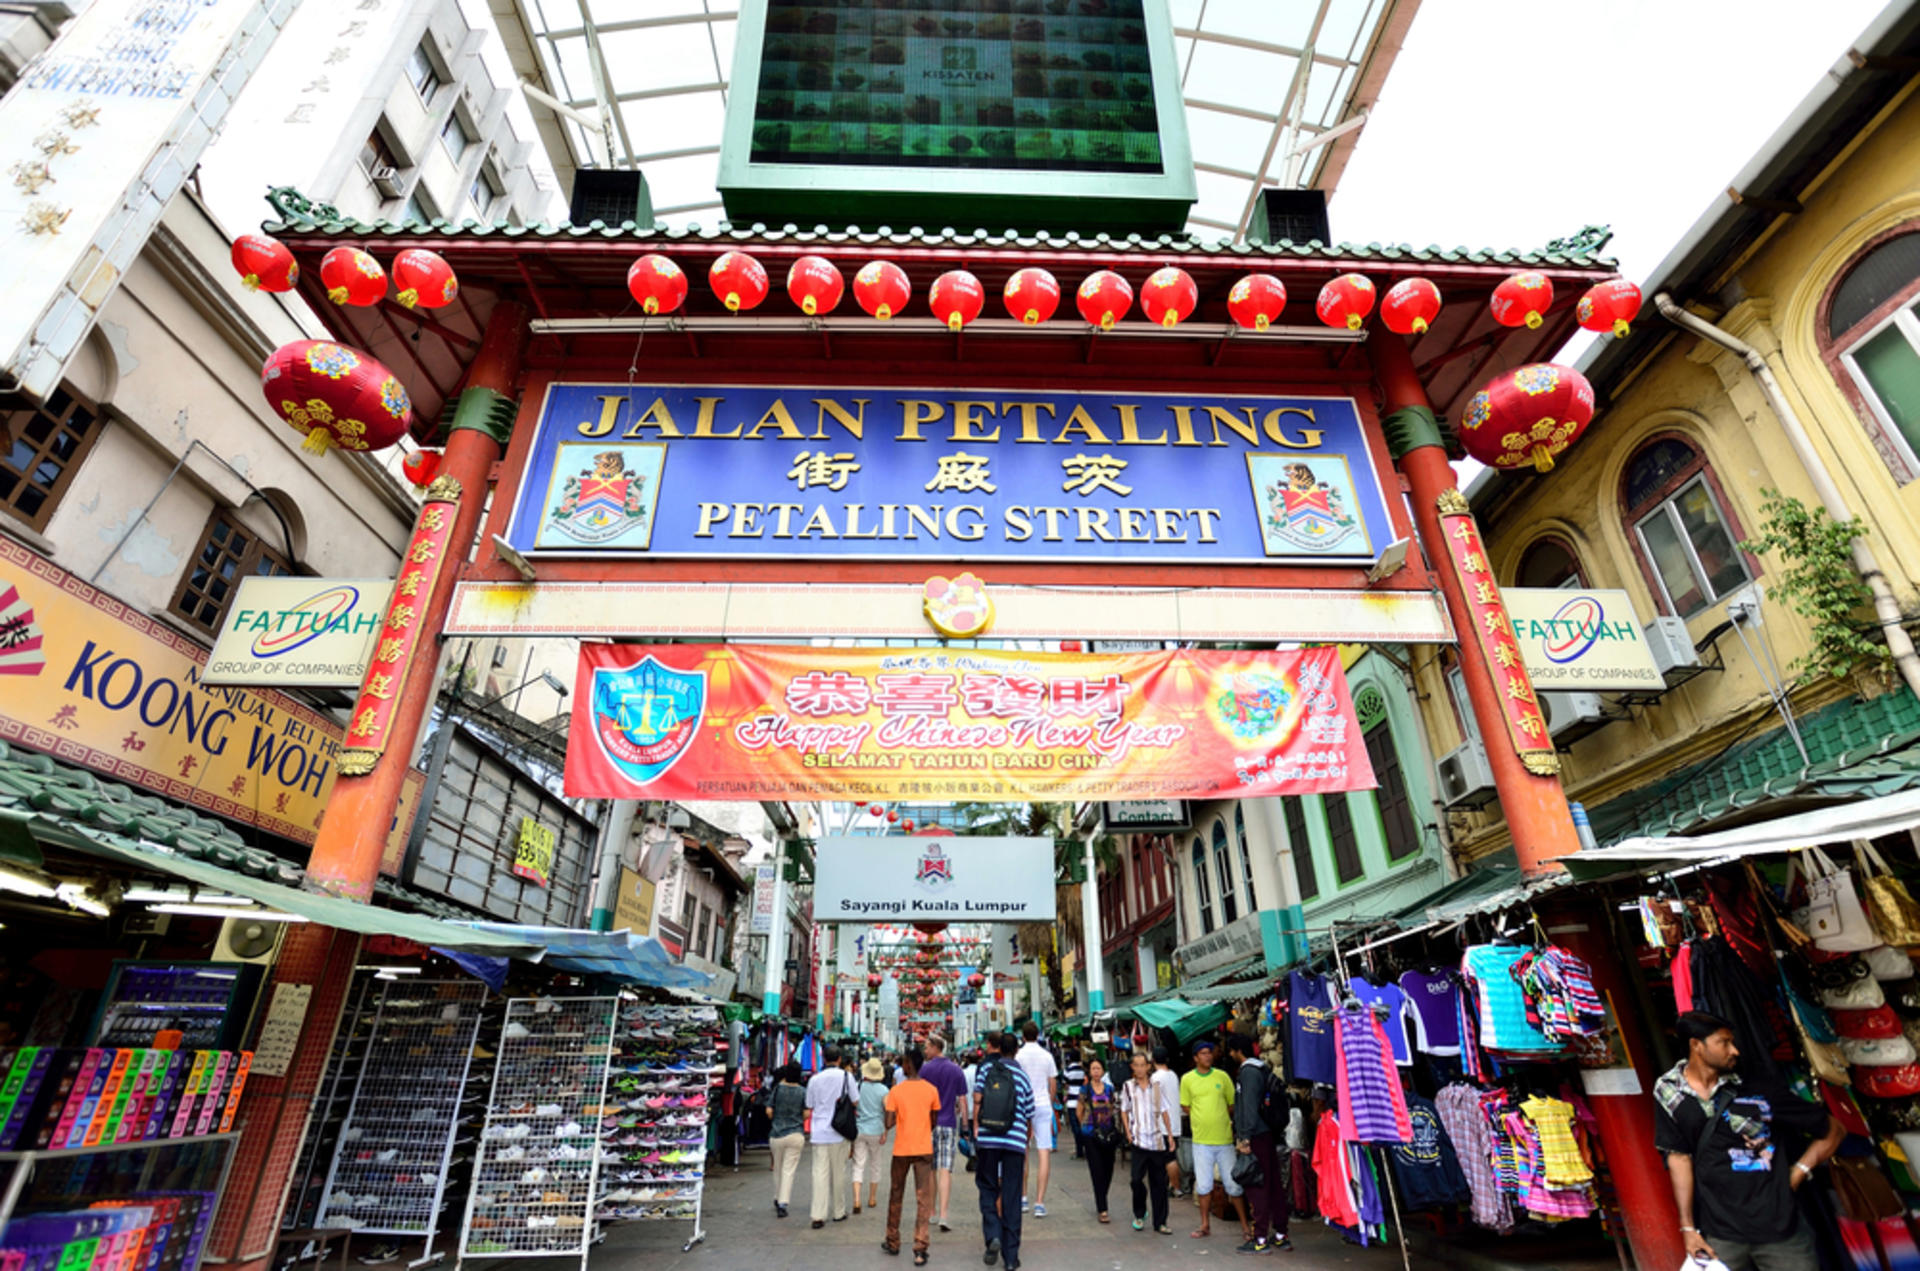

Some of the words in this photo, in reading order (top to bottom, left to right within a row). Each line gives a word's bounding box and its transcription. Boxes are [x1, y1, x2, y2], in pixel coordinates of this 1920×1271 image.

[923, 70, 995, 81] KISSATEN
[577, 395, 870, 440] JALAN
[895, 400, 1325, 449] PETALING
[694, 502, 988, 541] PETALING
[1004, 505, 1221, 544] STREET
[233, 609, 378, 635] FATTUAH
[1511, 618, 1637, 641] FATTUAH
[212, 661, 262, 674] GROUP
[262, 662, 284, 674] OF
[285, 663, 365, 677] COMPANIES
[1526, 667, 1568, 679] GROUP
[1569, 667, 1585, 679] OF
[1588, 668, 1657, 680] COMPANIES
[785, 670, 1130, 718] 恭喜發財
[63, 639, 237, 756] KOONG
[246, 726, 331, 798] WOH
[281, 717, 314, 745] JELI
[319, 736, 339, 759] HE
[735, 714, 871, 762] Happy
[876, 715, 1008, 748] Chinese
[1011, 716, 1090, 748] New
[1088, 715, 1185, 762] Year
[803, 752, 905, 769] SELAMAT
[910, 752, 987, 769] TAHUN
[994, 752, 1053, 769] BARU
[1058, 751, 1114, 769] CINA
[697, 780, 748, 794] PERSATUAN
[789, 781, 809, 794] DAN
[1118, 811, 1174, 822] Contact
[840, 899, 906, 914] Sayangi
[911, 899, 959, 911] Kuala
[964, 899, 1027, 914] Lumpur
